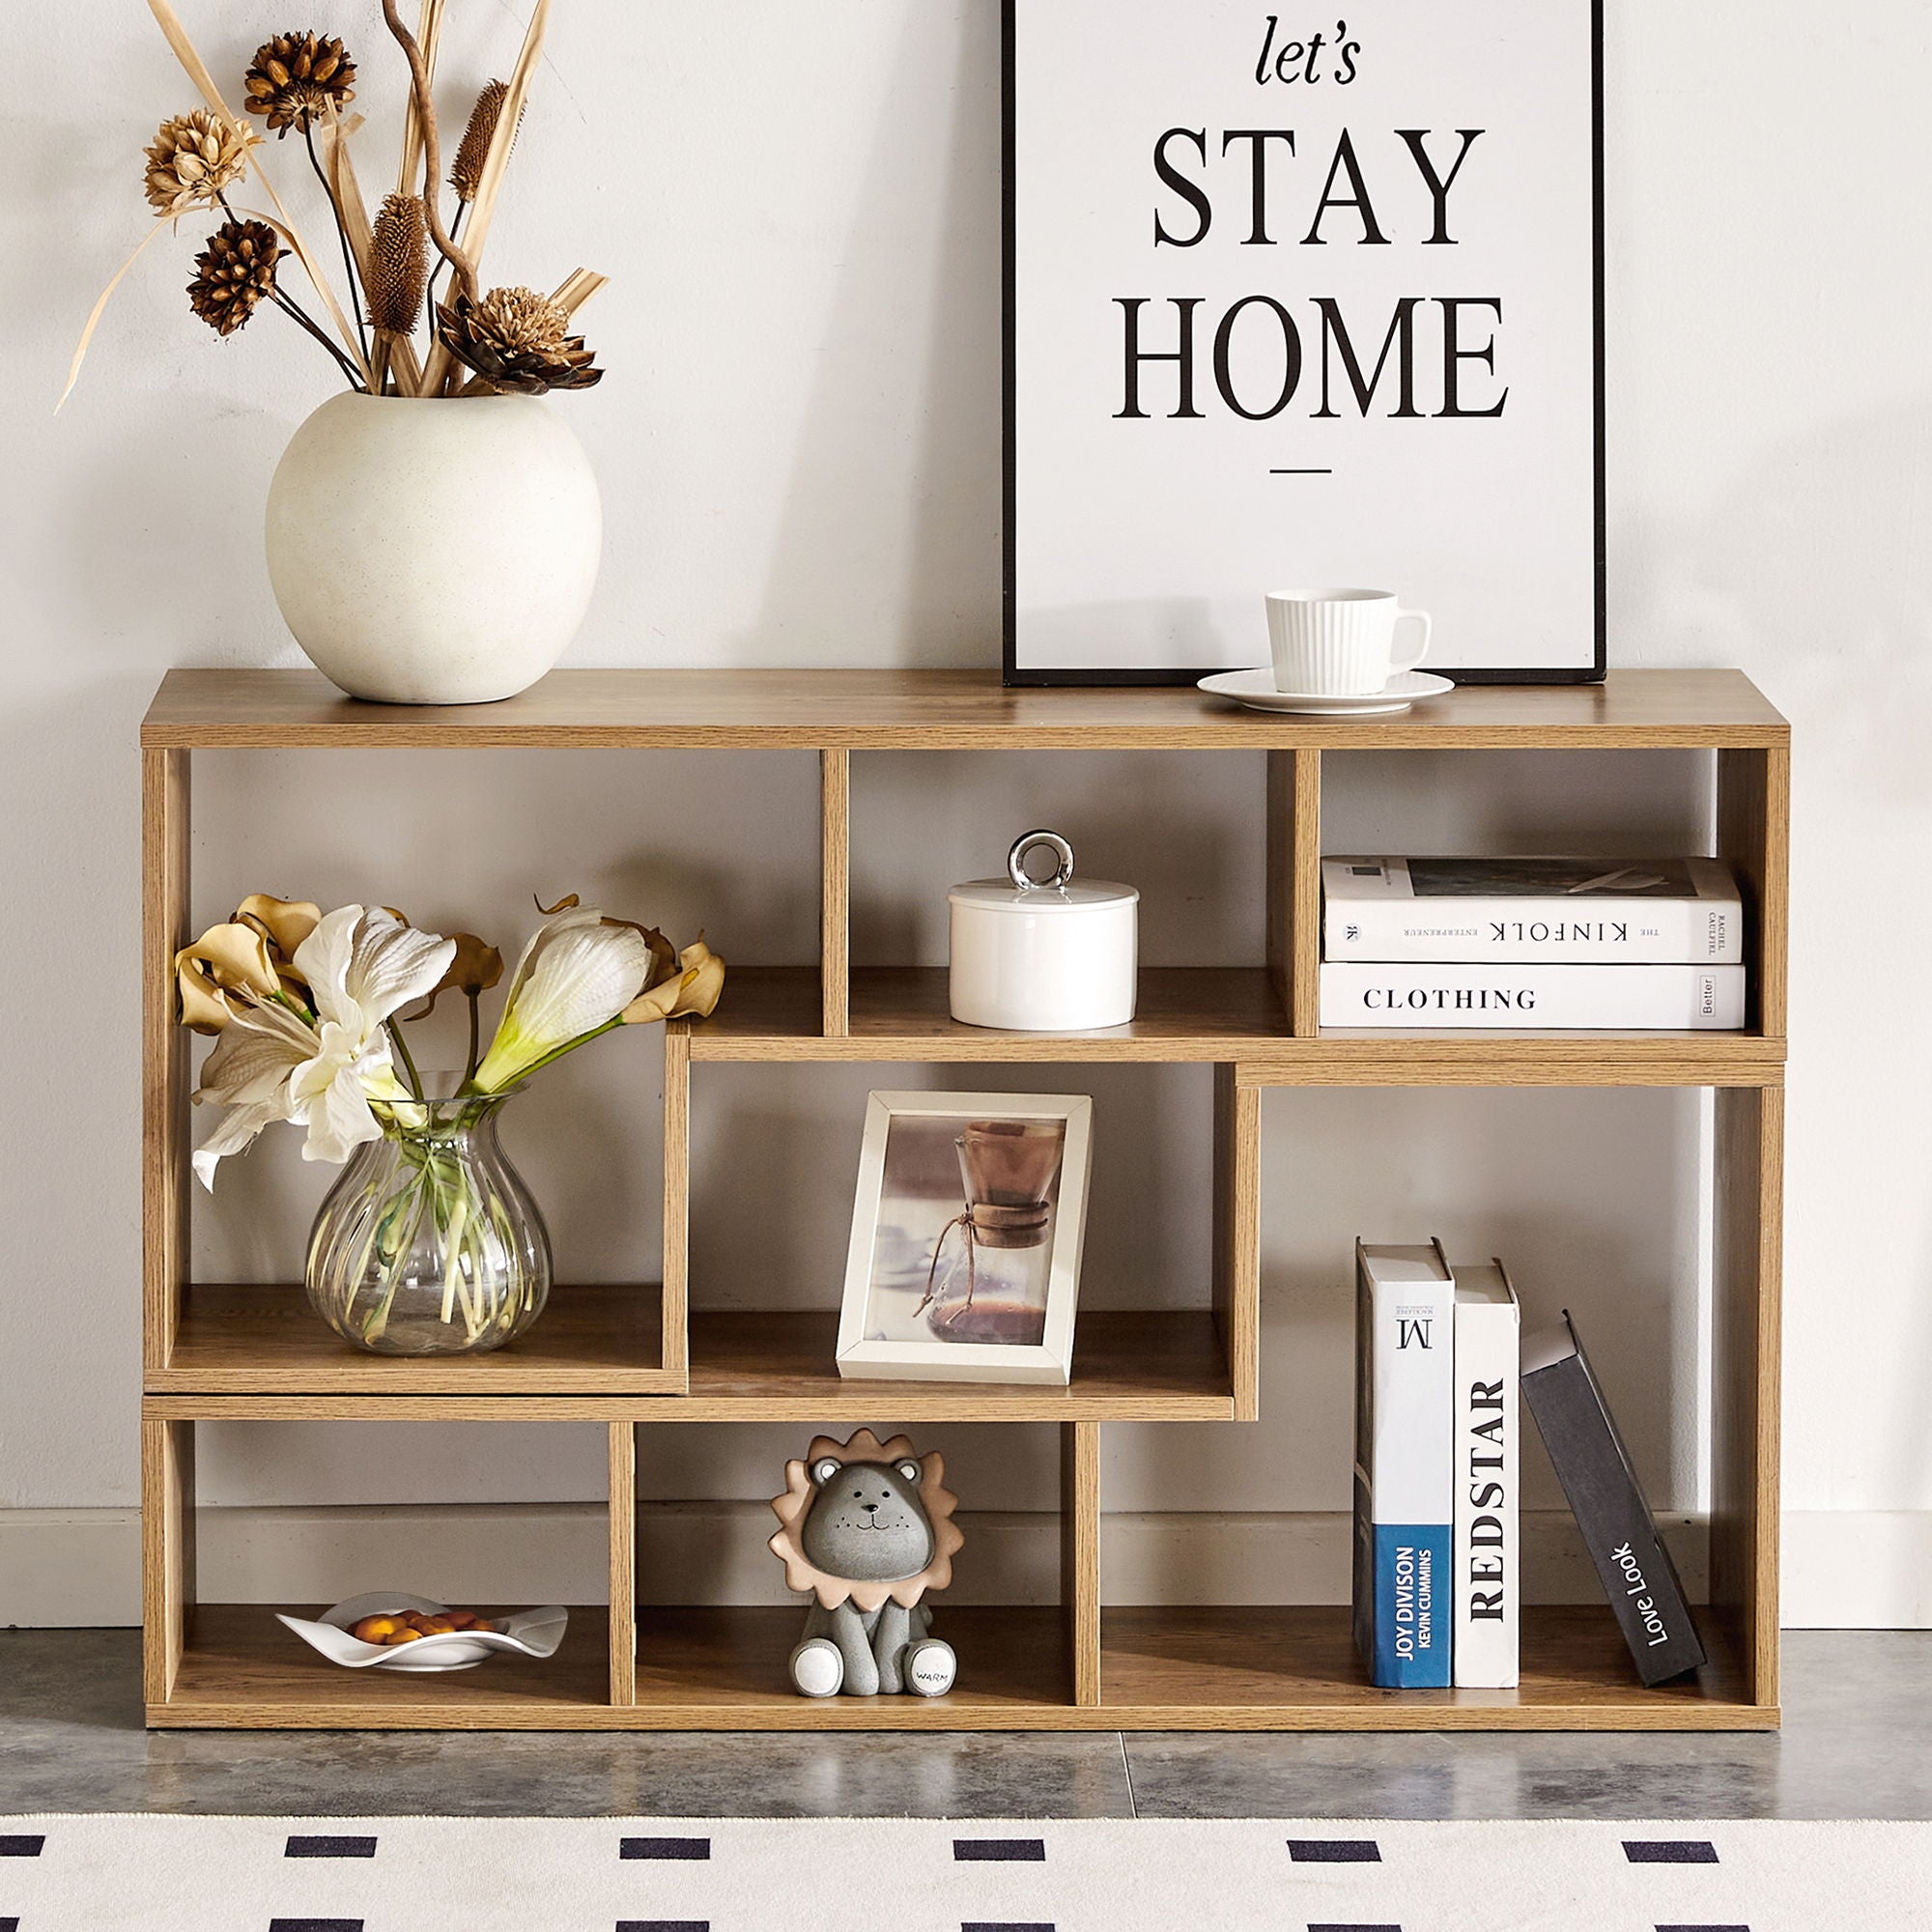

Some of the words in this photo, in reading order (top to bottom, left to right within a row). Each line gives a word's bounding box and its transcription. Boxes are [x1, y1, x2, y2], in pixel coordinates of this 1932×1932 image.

[1255, 15, 1361, 85] let’s
[1153, 128, 1486, 247] STAY
[1112, 295, 1509, 421] HOME
[1489, 923, 1628, 942] KINFOLK
[1363, 988, 1536, 1009] CLOTHING
[1703, 980, 1713, 1014] Better
[1396, 1319, 1434, 1350] M
[1470, 1377, 1504, 1623] REDSTAR
[1396, 1547, 1413, 1622] DIVISON
[1418, 1548, 1432, 1610] CUMMINS
[1610, 1542, 1647, 1596] Look
[1396, 1626, 1413, 1662] JOY
[1418, 1612, 1431, 1648] KEVIN
[1636, 1596, 1668, 1647] Love
[917, 1672, 949, 1682] WARM
